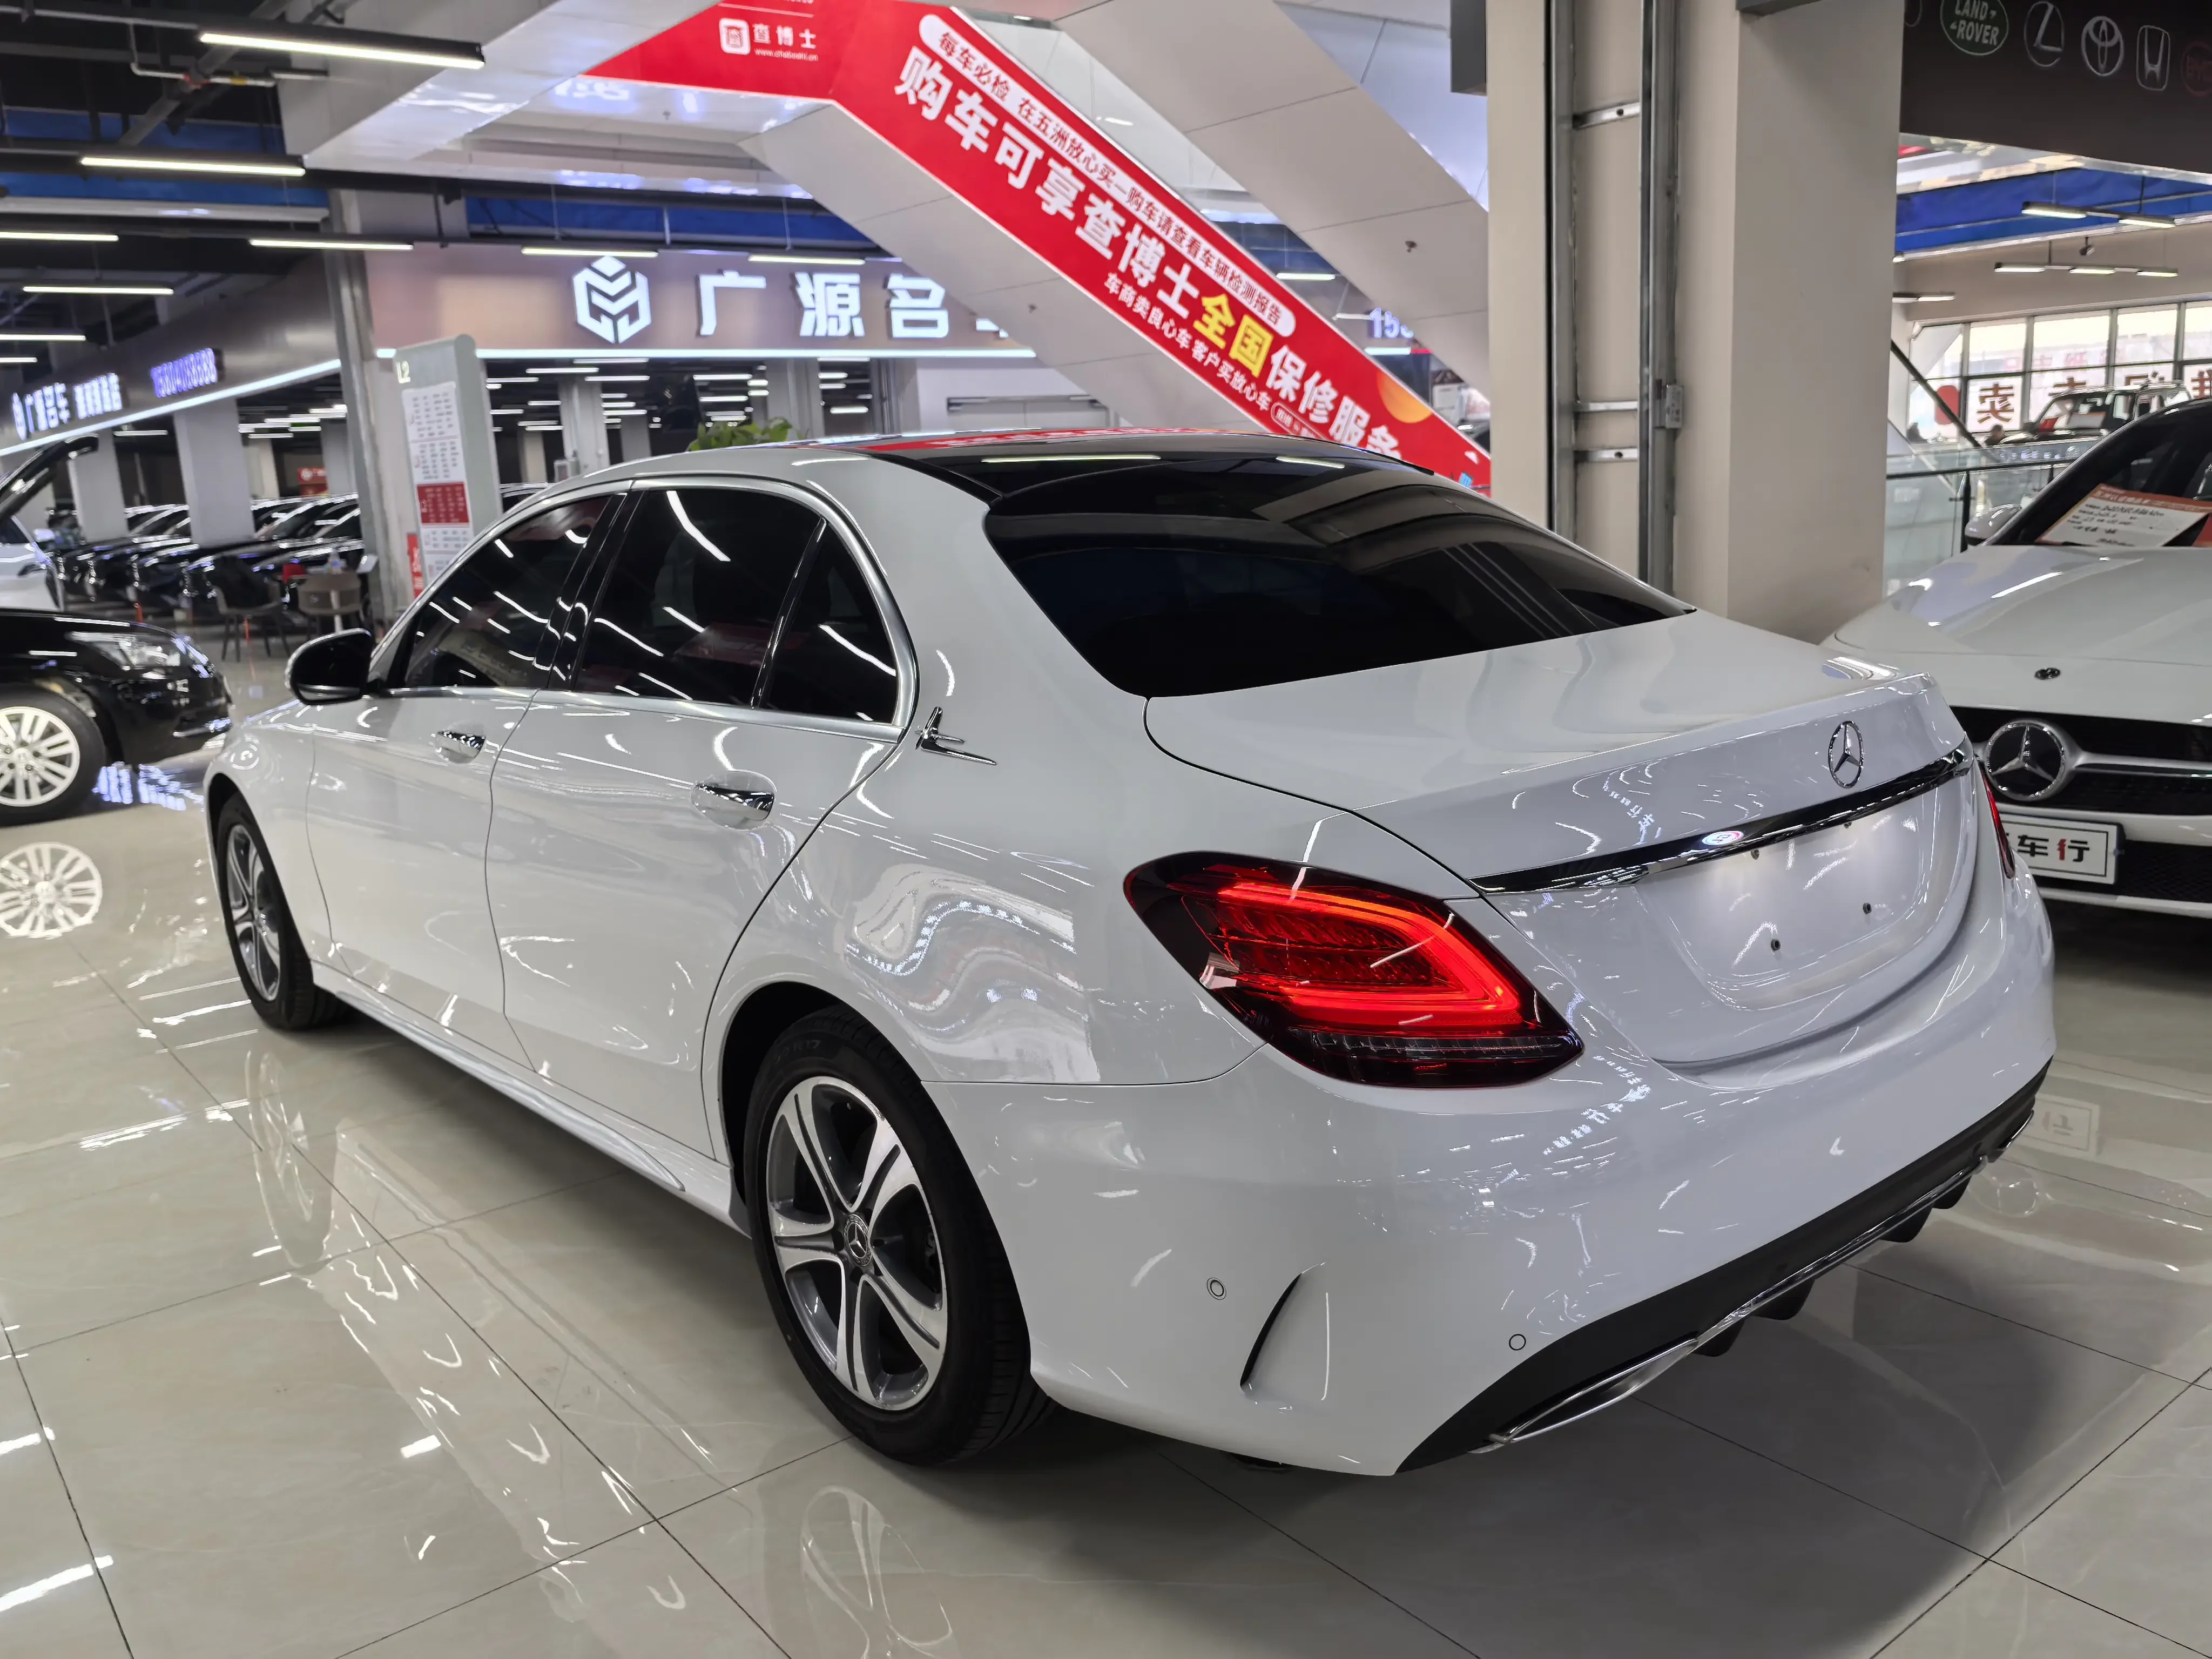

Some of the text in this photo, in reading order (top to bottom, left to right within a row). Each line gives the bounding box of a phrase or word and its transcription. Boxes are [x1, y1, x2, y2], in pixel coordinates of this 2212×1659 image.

[1957, 19, 1999, 46] ROVER
[939, 31, 1011, 103] 每车必检
[698, 270, 1009, 338] 广源名
[2005, 833, 2090, 864] 车行
